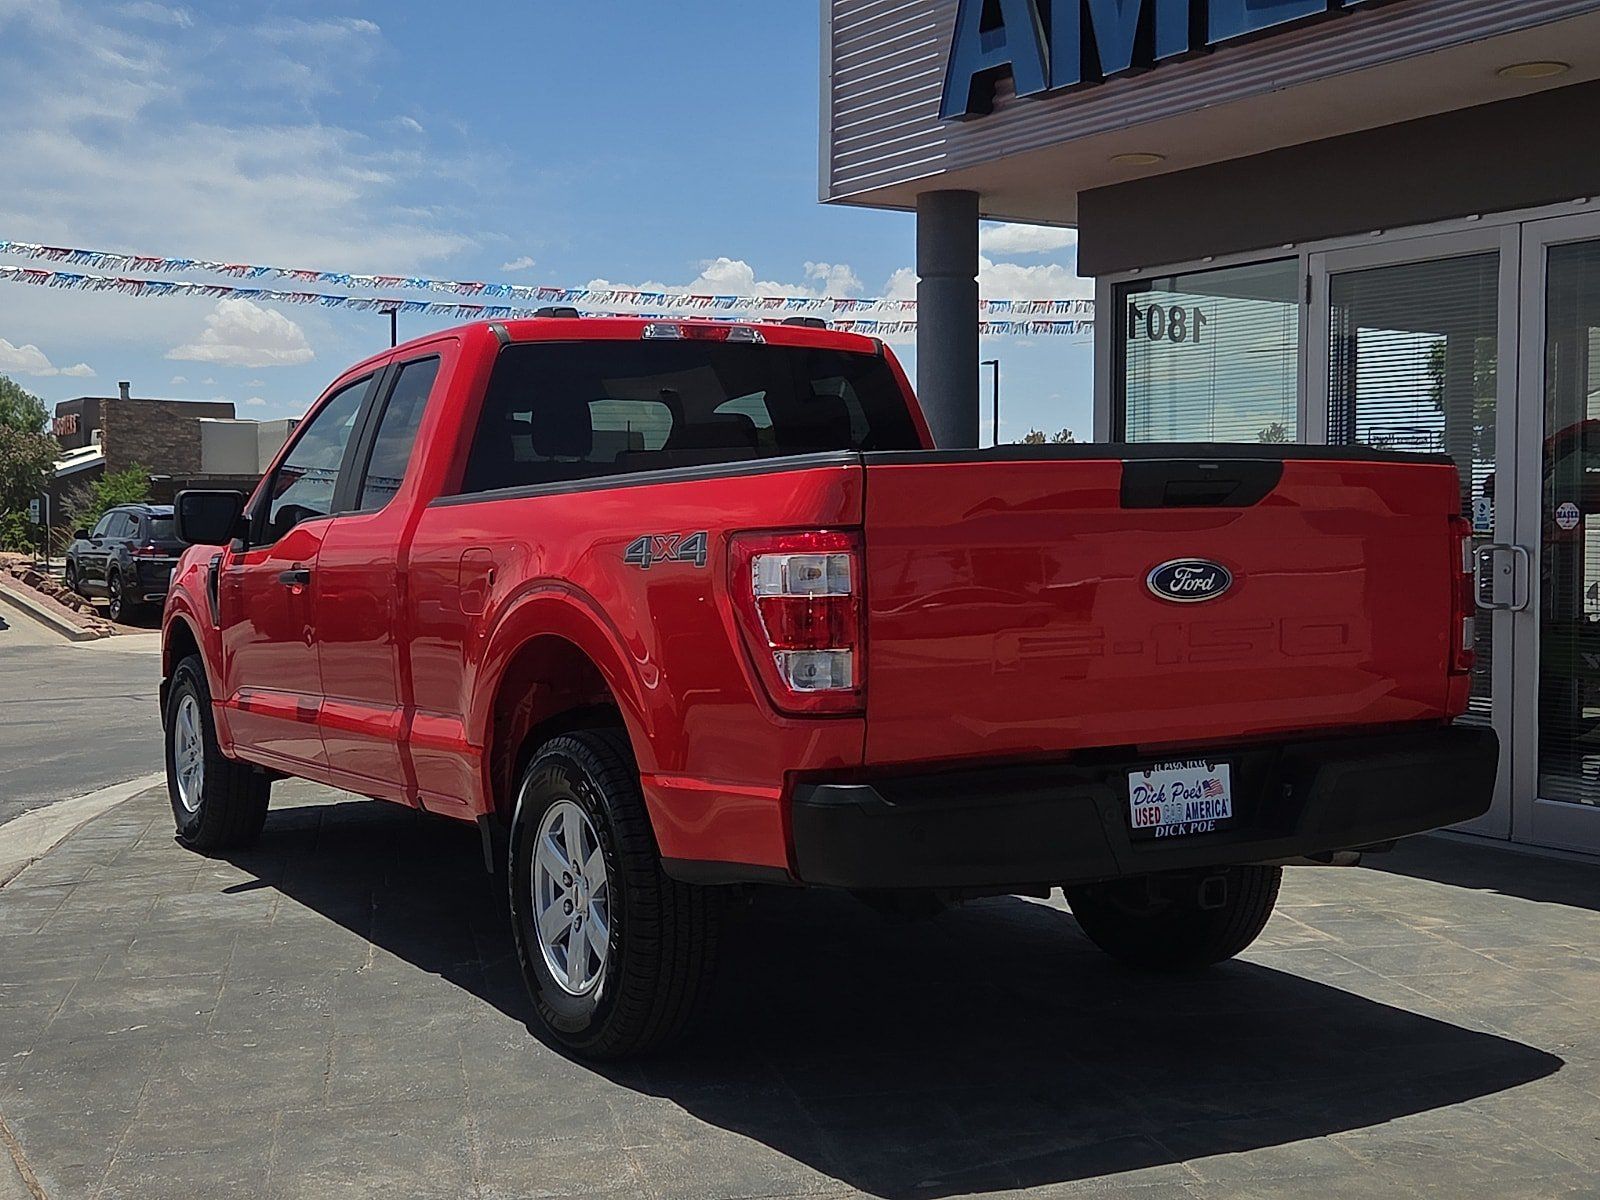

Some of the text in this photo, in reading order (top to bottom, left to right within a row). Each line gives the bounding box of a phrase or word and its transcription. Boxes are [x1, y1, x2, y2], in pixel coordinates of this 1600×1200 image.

[1169, 566, 1216, 592] Ford
[993, 617, 1360, 675] F-150
[1133, 780, 1202, 806] Dick Poe's
[1134, 799, 1228, 827] USED CAR AMERICA
[1155, 820, 1216, 838] DICK POE
